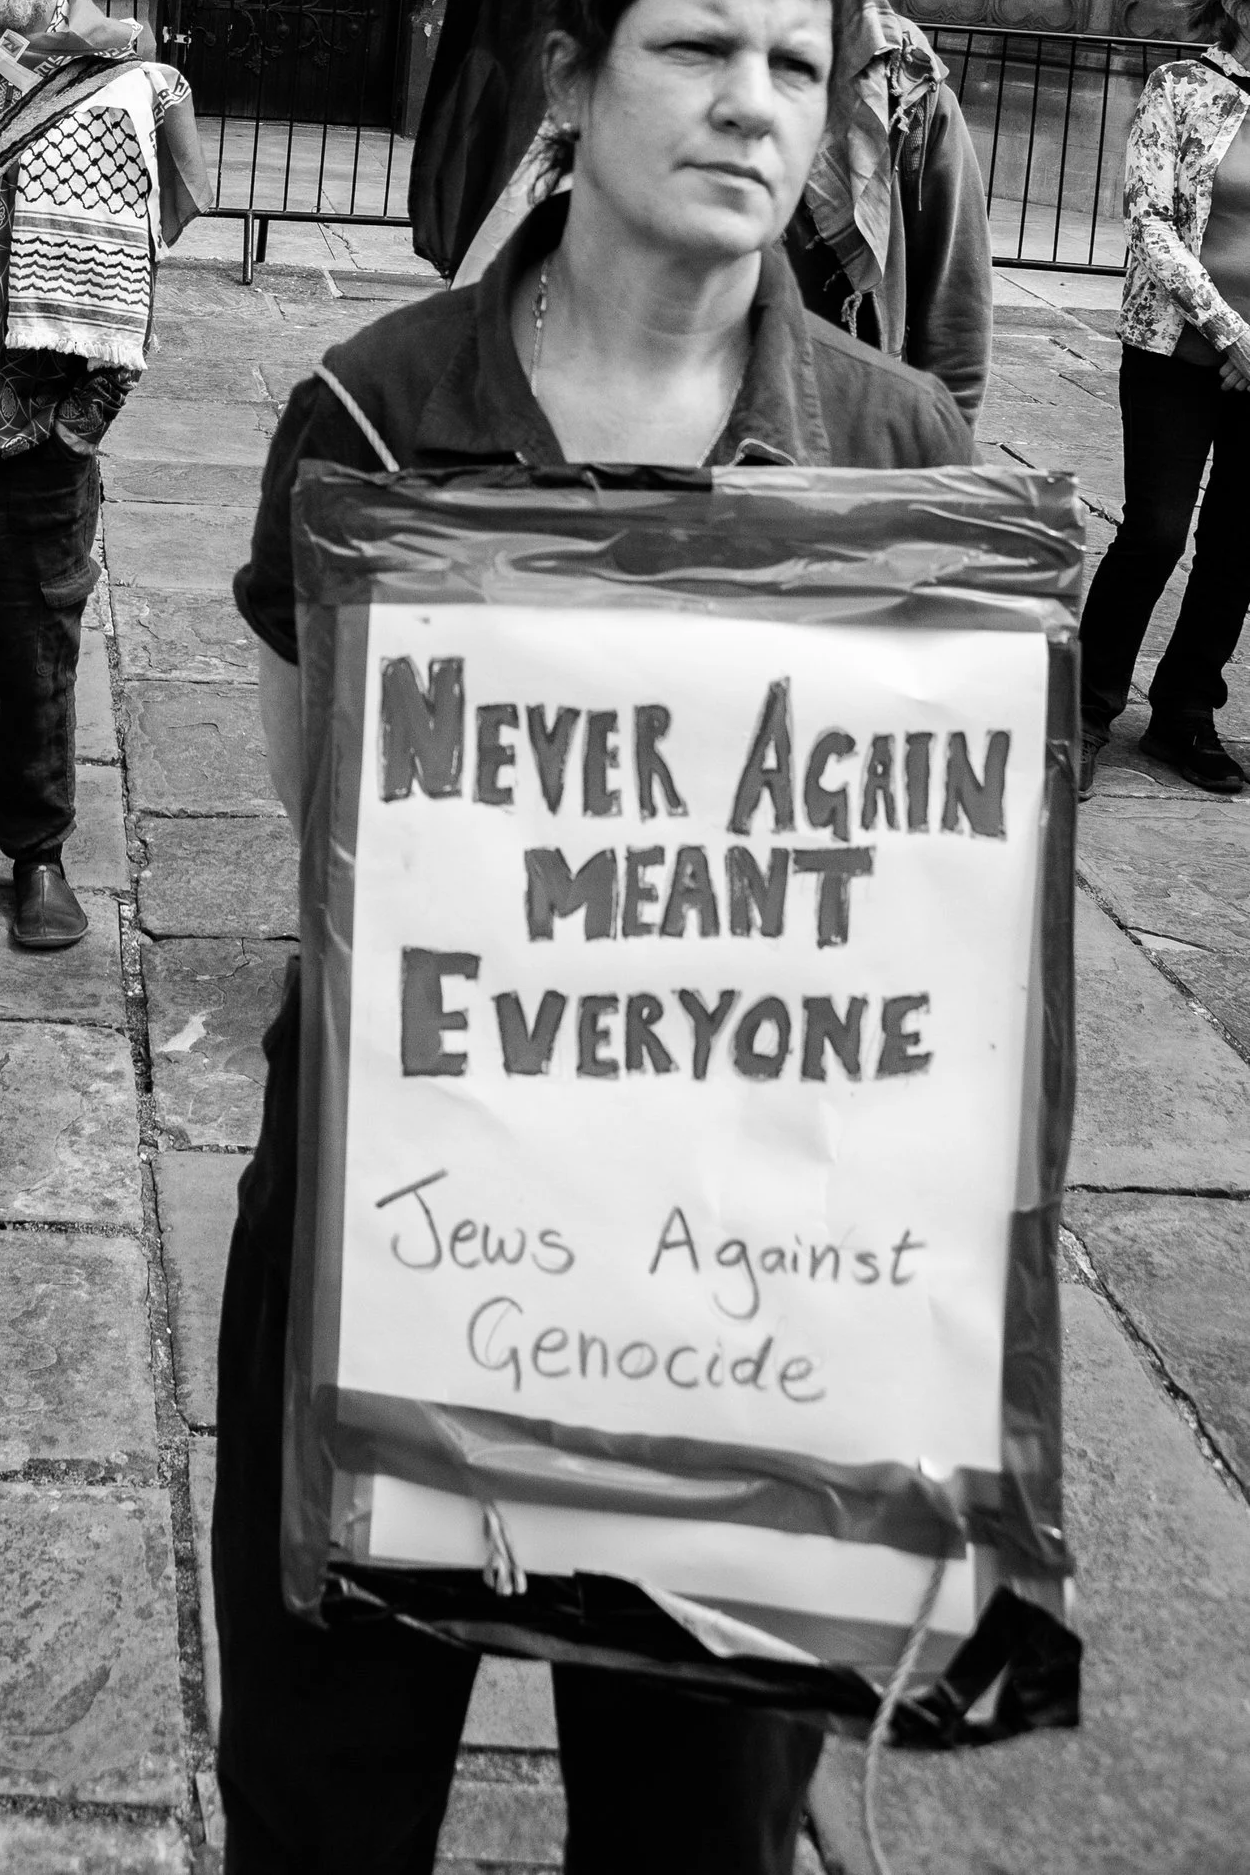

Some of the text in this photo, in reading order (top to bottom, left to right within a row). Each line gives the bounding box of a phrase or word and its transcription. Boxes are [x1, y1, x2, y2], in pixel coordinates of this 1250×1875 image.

[378, 655, 1012, 842] NEVER AGAIN
[524, 845, 877, 949] MEANT
[400, 945, 934, 1081] EVERYONE
[375, 1168, 928, 1320] Jews Against
[467, 1295, 828, 1403] Genocide
